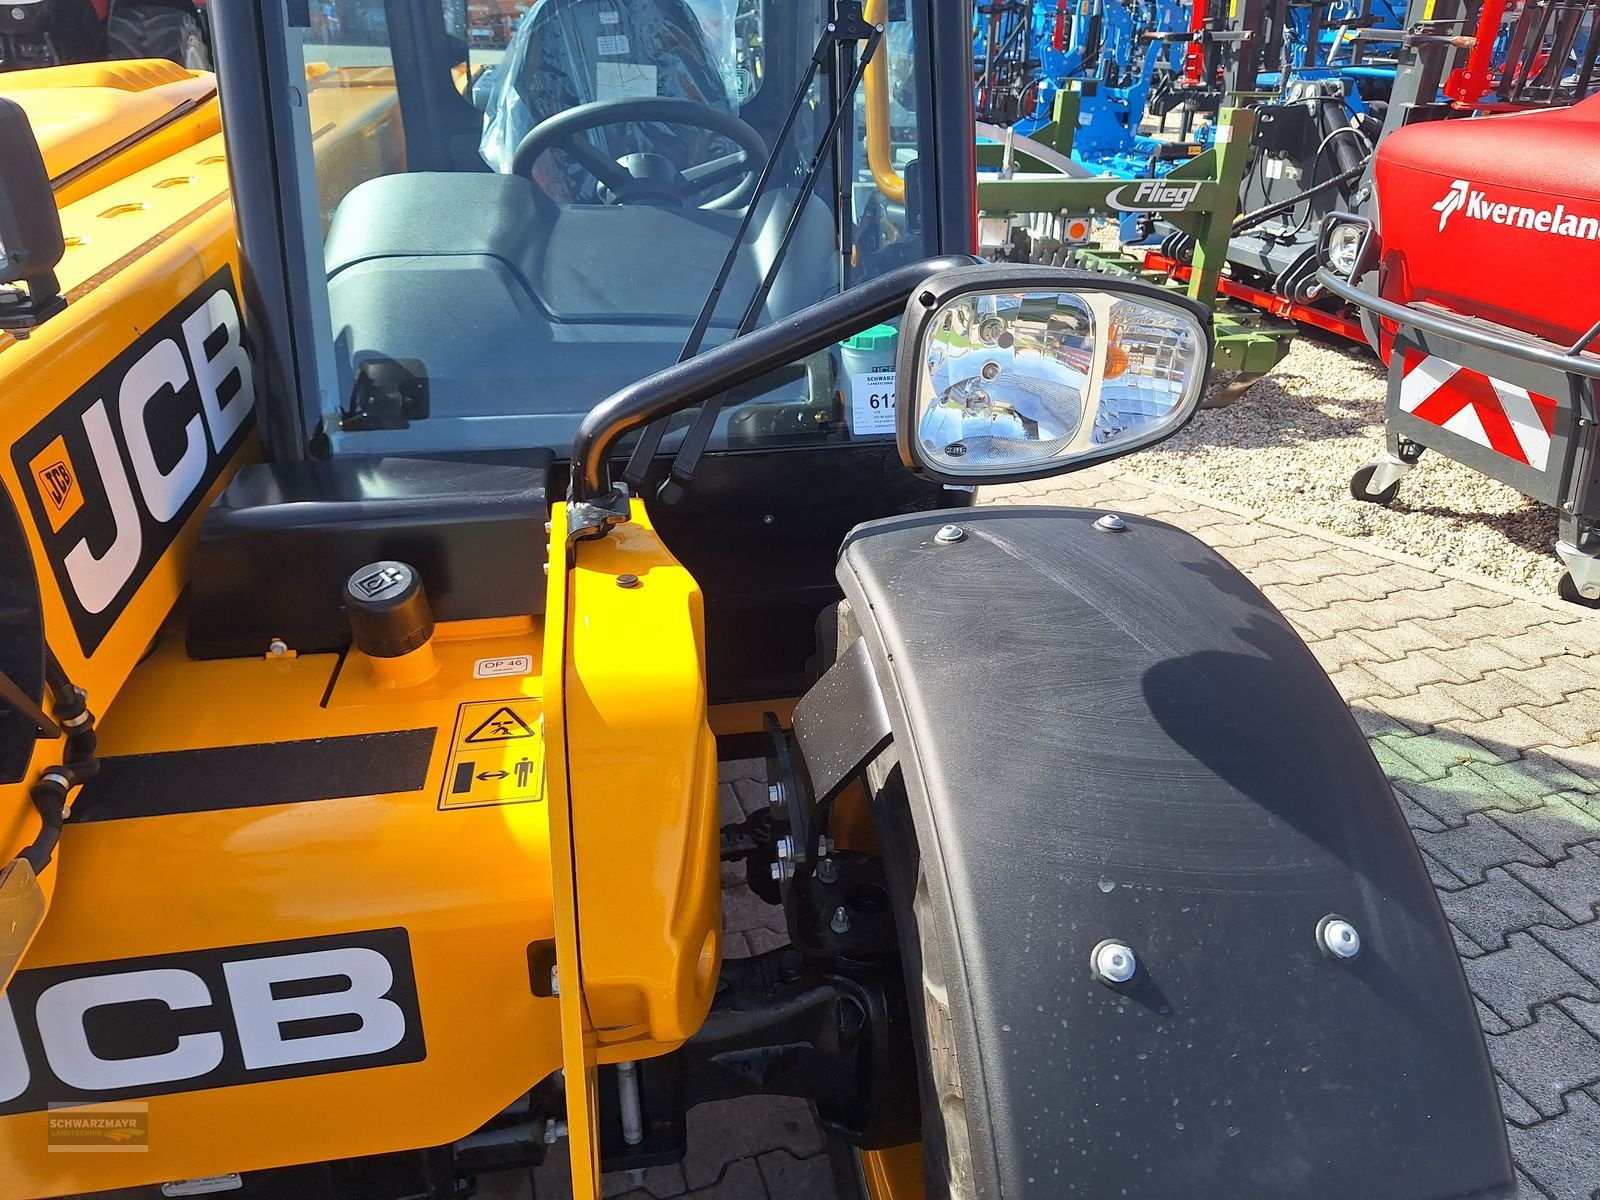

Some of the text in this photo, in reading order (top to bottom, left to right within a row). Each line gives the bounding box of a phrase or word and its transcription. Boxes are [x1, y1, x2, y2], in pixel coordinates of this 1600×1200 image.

[1133, 182, 1202, 208] Fliegl
[1465, 190, 1600, 240] Kvernelan
[63, 288, 255, 614] JCB
[44, 464, 71, 505] JCB
[484, 661, 504, 669] OP
[0, 947, 406, 1102] CB
